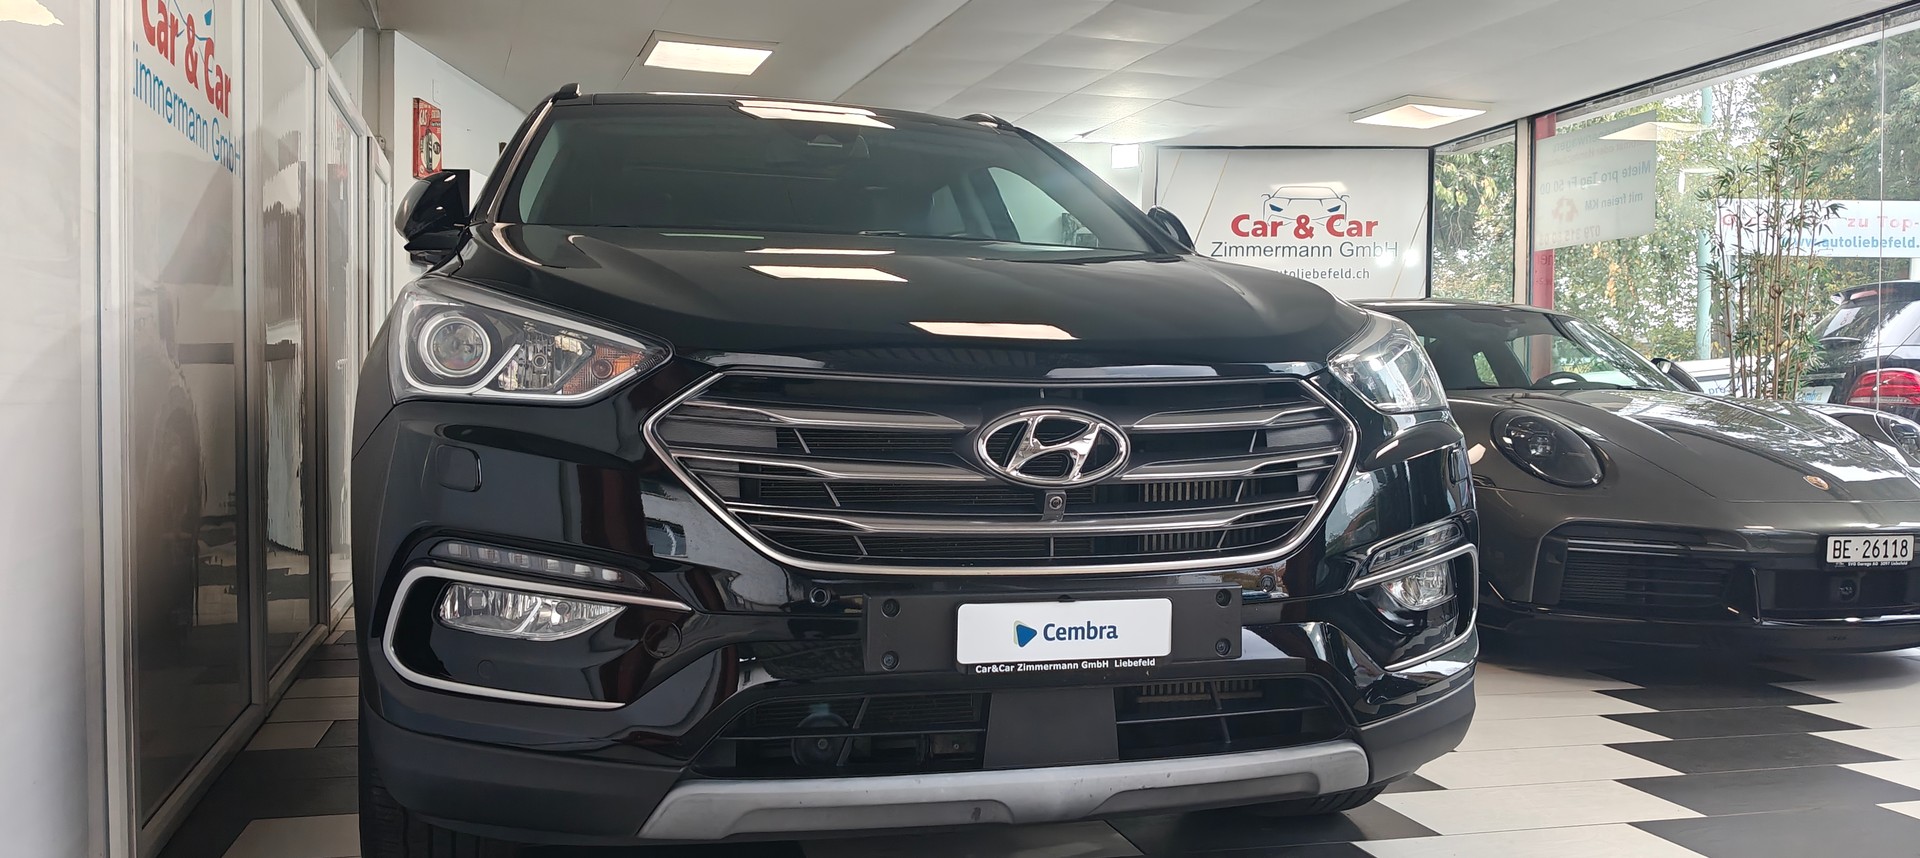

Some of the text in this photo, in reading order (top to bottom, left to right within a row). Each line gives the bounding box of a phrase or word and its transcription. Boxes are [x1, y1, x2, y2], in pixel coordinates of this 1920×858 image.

[141, 0, 231, 119] Car & Car
[133, 40, 241, 178] immermann GmbH
[1230, 213, 1379, 239] Car & Car
[1848, 217, 1869, 228] zu
[1210, 241, 1399, 259] Zimmermann GmbH
[1043, 620, 1119, 642] Cembra
[975, 658, 1156, 674] Car&Car Zimmermann GmbH Liebefeld
